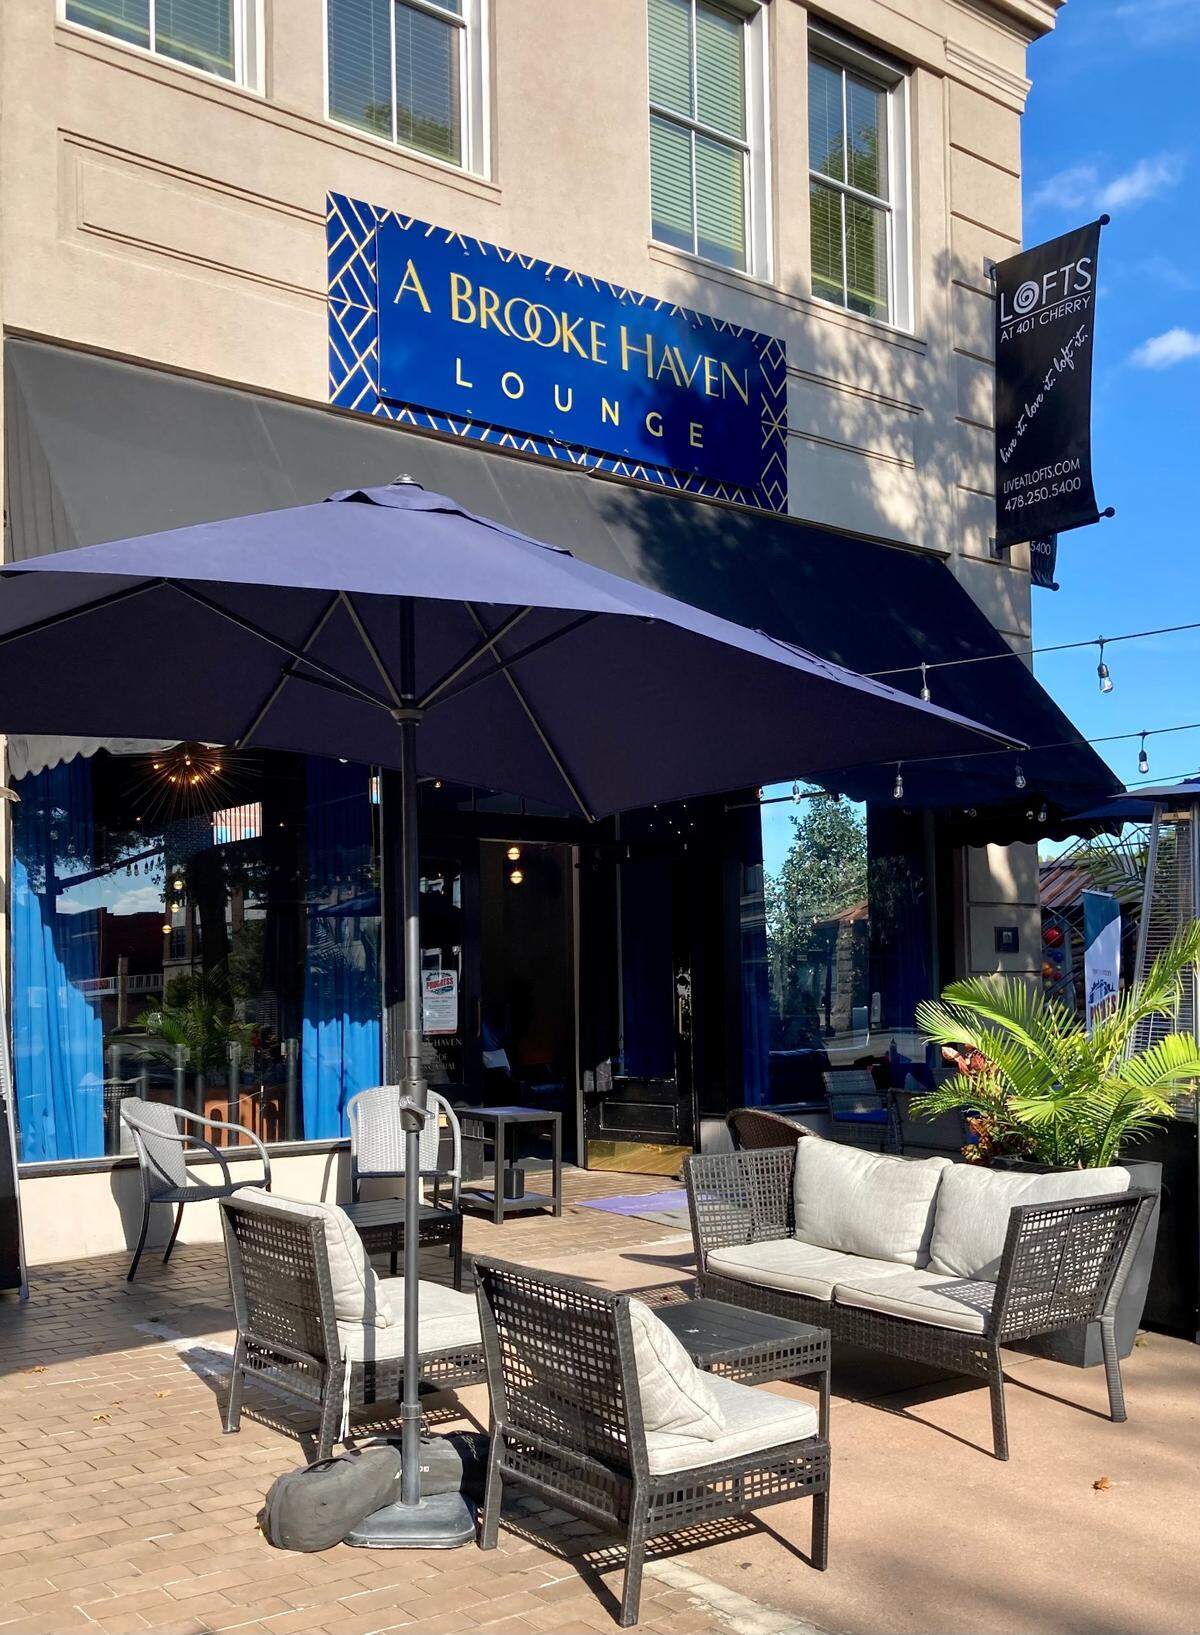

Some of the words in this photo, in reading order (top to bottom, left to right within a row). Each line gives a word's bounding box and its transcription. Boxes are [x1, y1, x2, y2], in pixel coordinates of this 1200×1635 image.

[1000, 257, 1092, 323] LOFTS
[1000, 326, 1015, 343] AT
[1016, 317, 1035, 335] 401
[1039, 296, 1091, 325] CHERRY
[394, 259, 432, 313] A
[450, 271, 608, 365] BROOKE
[620, 325, 749, 406] HAVEN
[456, 357, 704, 449] LOUNGE
[1000, 438, 1017, 464] live
[1025, 393, 1044, 418] love
[1053, 338, 1075, 372] loft
[1003, 458, 1081, 494] LIVEATLOFTS.COM
[1004, 477, 1082, 512] 478.250.5400
